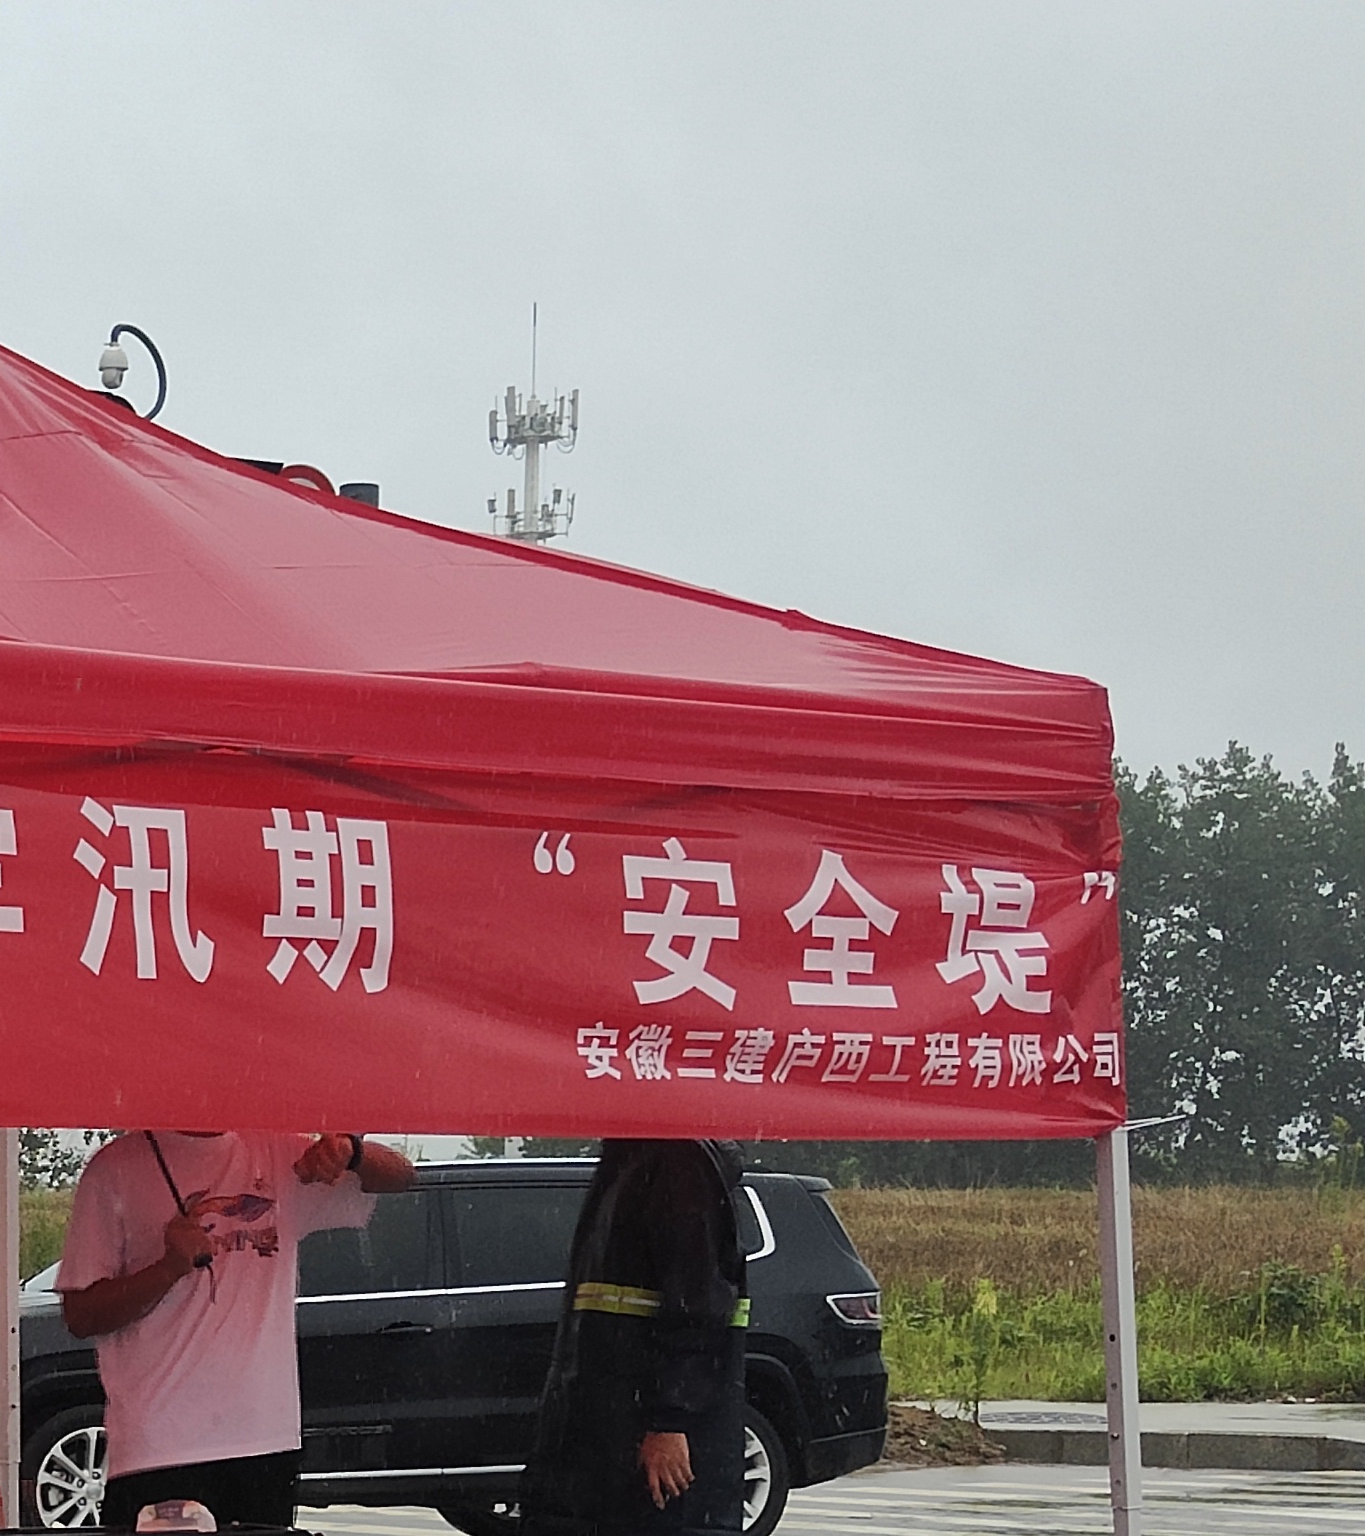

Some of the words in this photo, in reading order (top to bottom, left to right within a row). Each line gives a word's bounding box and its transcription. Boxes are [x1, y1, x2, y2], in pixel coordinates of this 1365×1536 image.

[575, 1021, 1122, 1088] 安徽三建庐西工程有限公司
